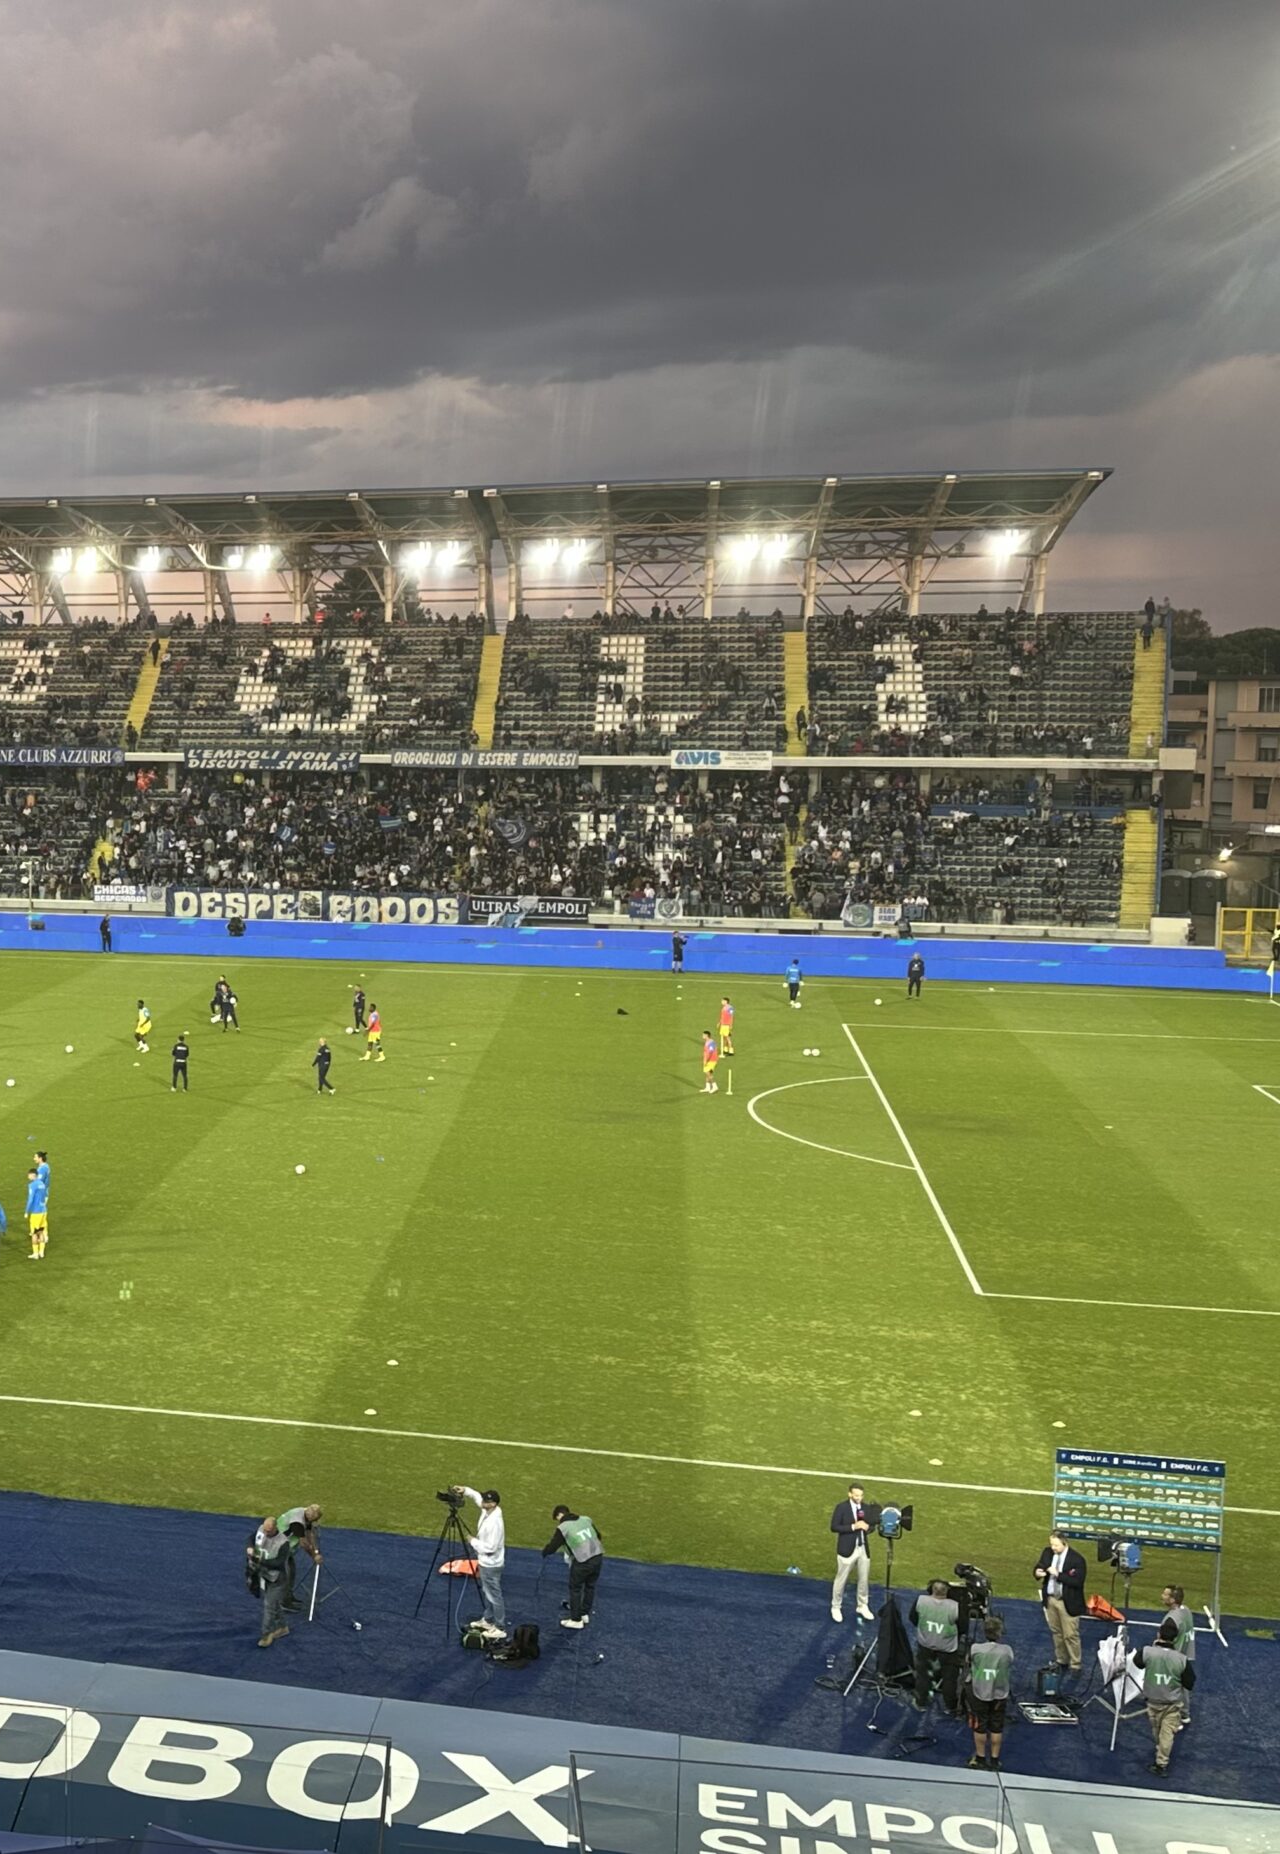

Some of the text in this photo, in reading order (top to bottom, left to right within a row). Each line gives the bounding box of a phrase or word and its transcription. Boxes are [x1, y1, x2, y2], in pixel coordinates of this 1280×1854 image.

[19, 748, 56, 762] CLUBS
[59, 750, 111, 763] AZZURRI
[188, 750, 358, 760] L'EMPOLI NON SI
[394, 752, 576, 766] ORGOGLIOSI DI ESSERE EMPOLESI
[675, 752, 720, 765] AVIS
[298, 761, 338, 770] AMA
[94, 885, 136, 894] CHICAS
[472, 900, 587, 915] ULTRAS EMPOLI
[1071, 1454, 1096, 1463] EMPOLI
[1170, 1463, 1196, 1471] EMPOLI
[576, 1528, 592, 1540] TV
[926, 1620, 944, 1634] TV
[1154, 1673, 1173, 1685] TV
